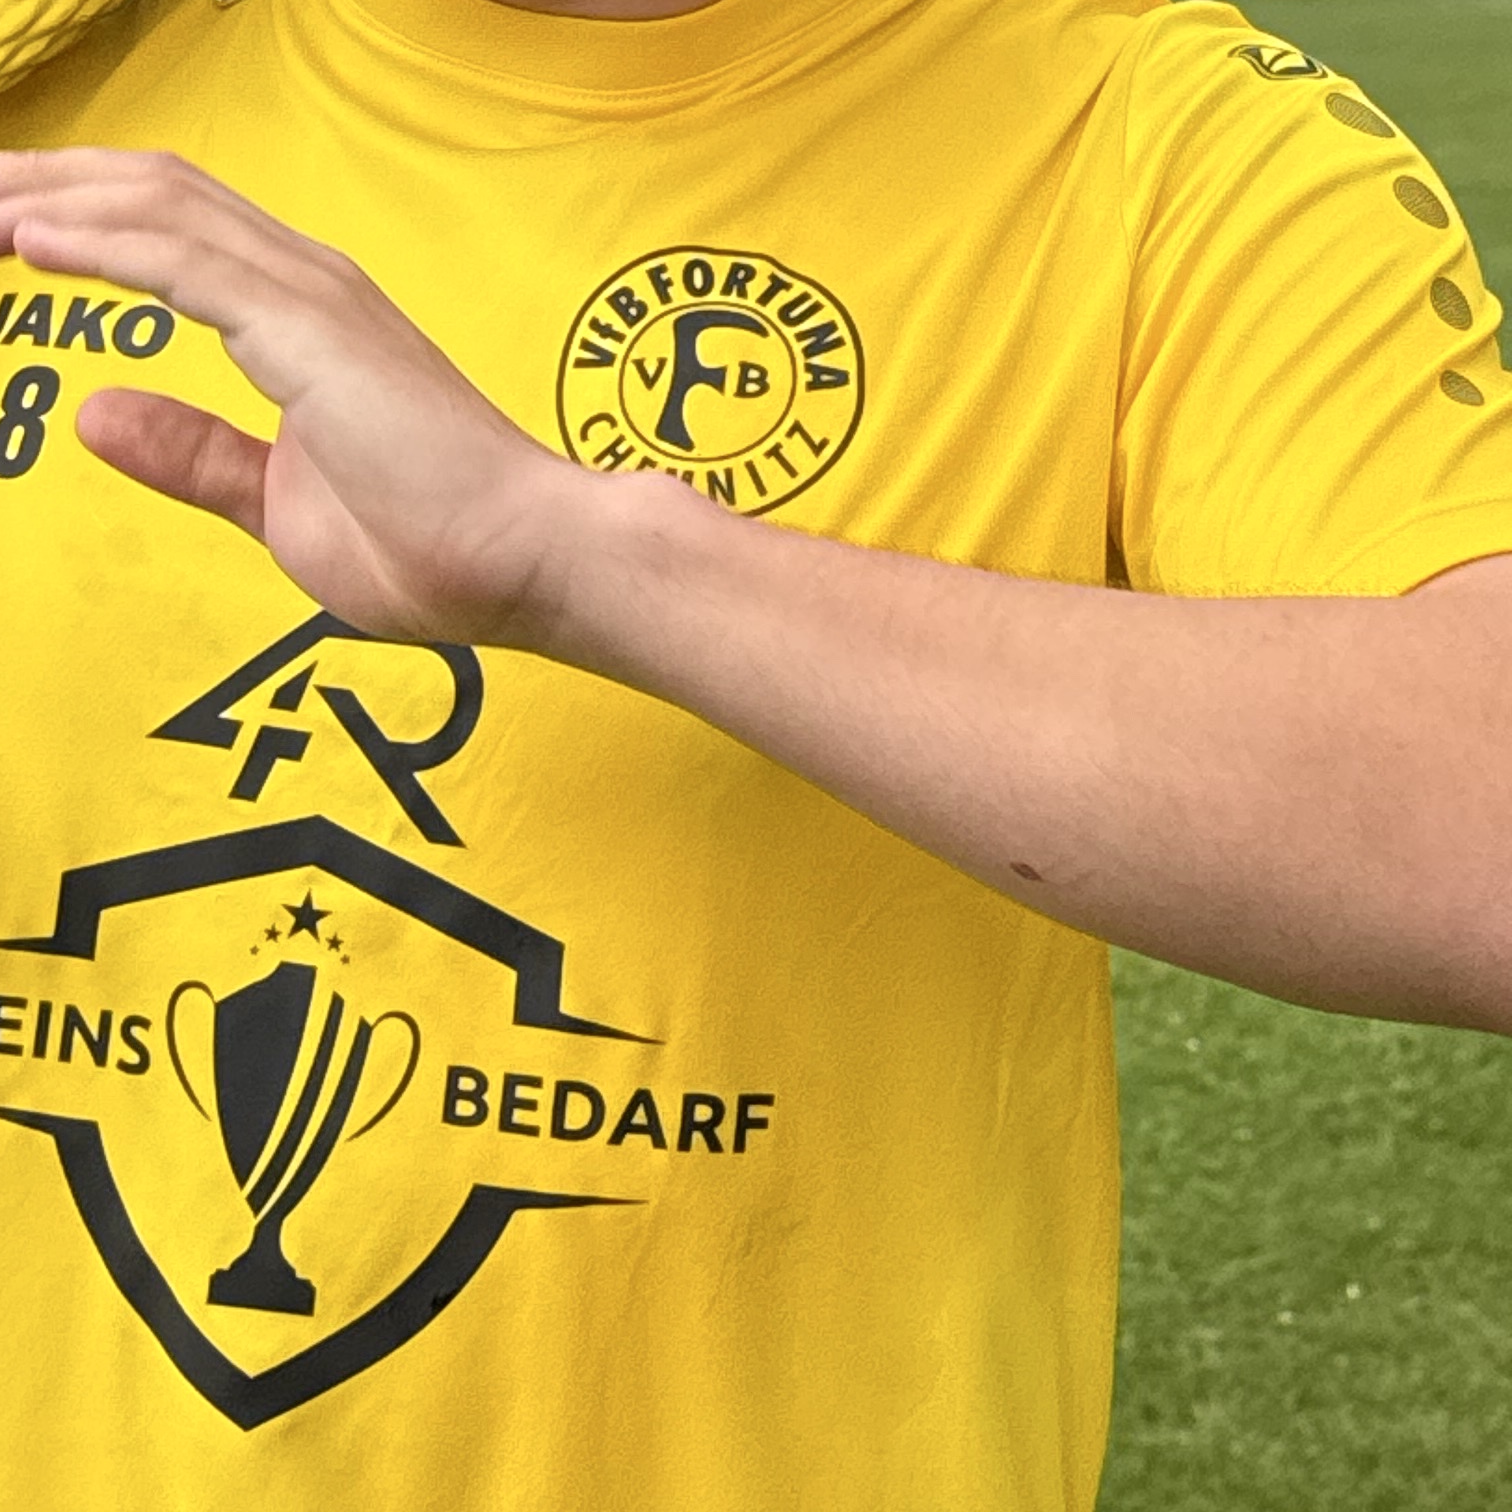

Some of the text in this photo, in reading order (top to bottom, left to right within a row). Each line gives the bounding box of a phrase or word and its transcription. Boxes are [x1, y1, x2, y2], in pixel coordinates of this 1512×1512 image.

[573, 258, 850, 393] VfB FORTUNA
[440, 1065, 776, 1155] BEDARF
